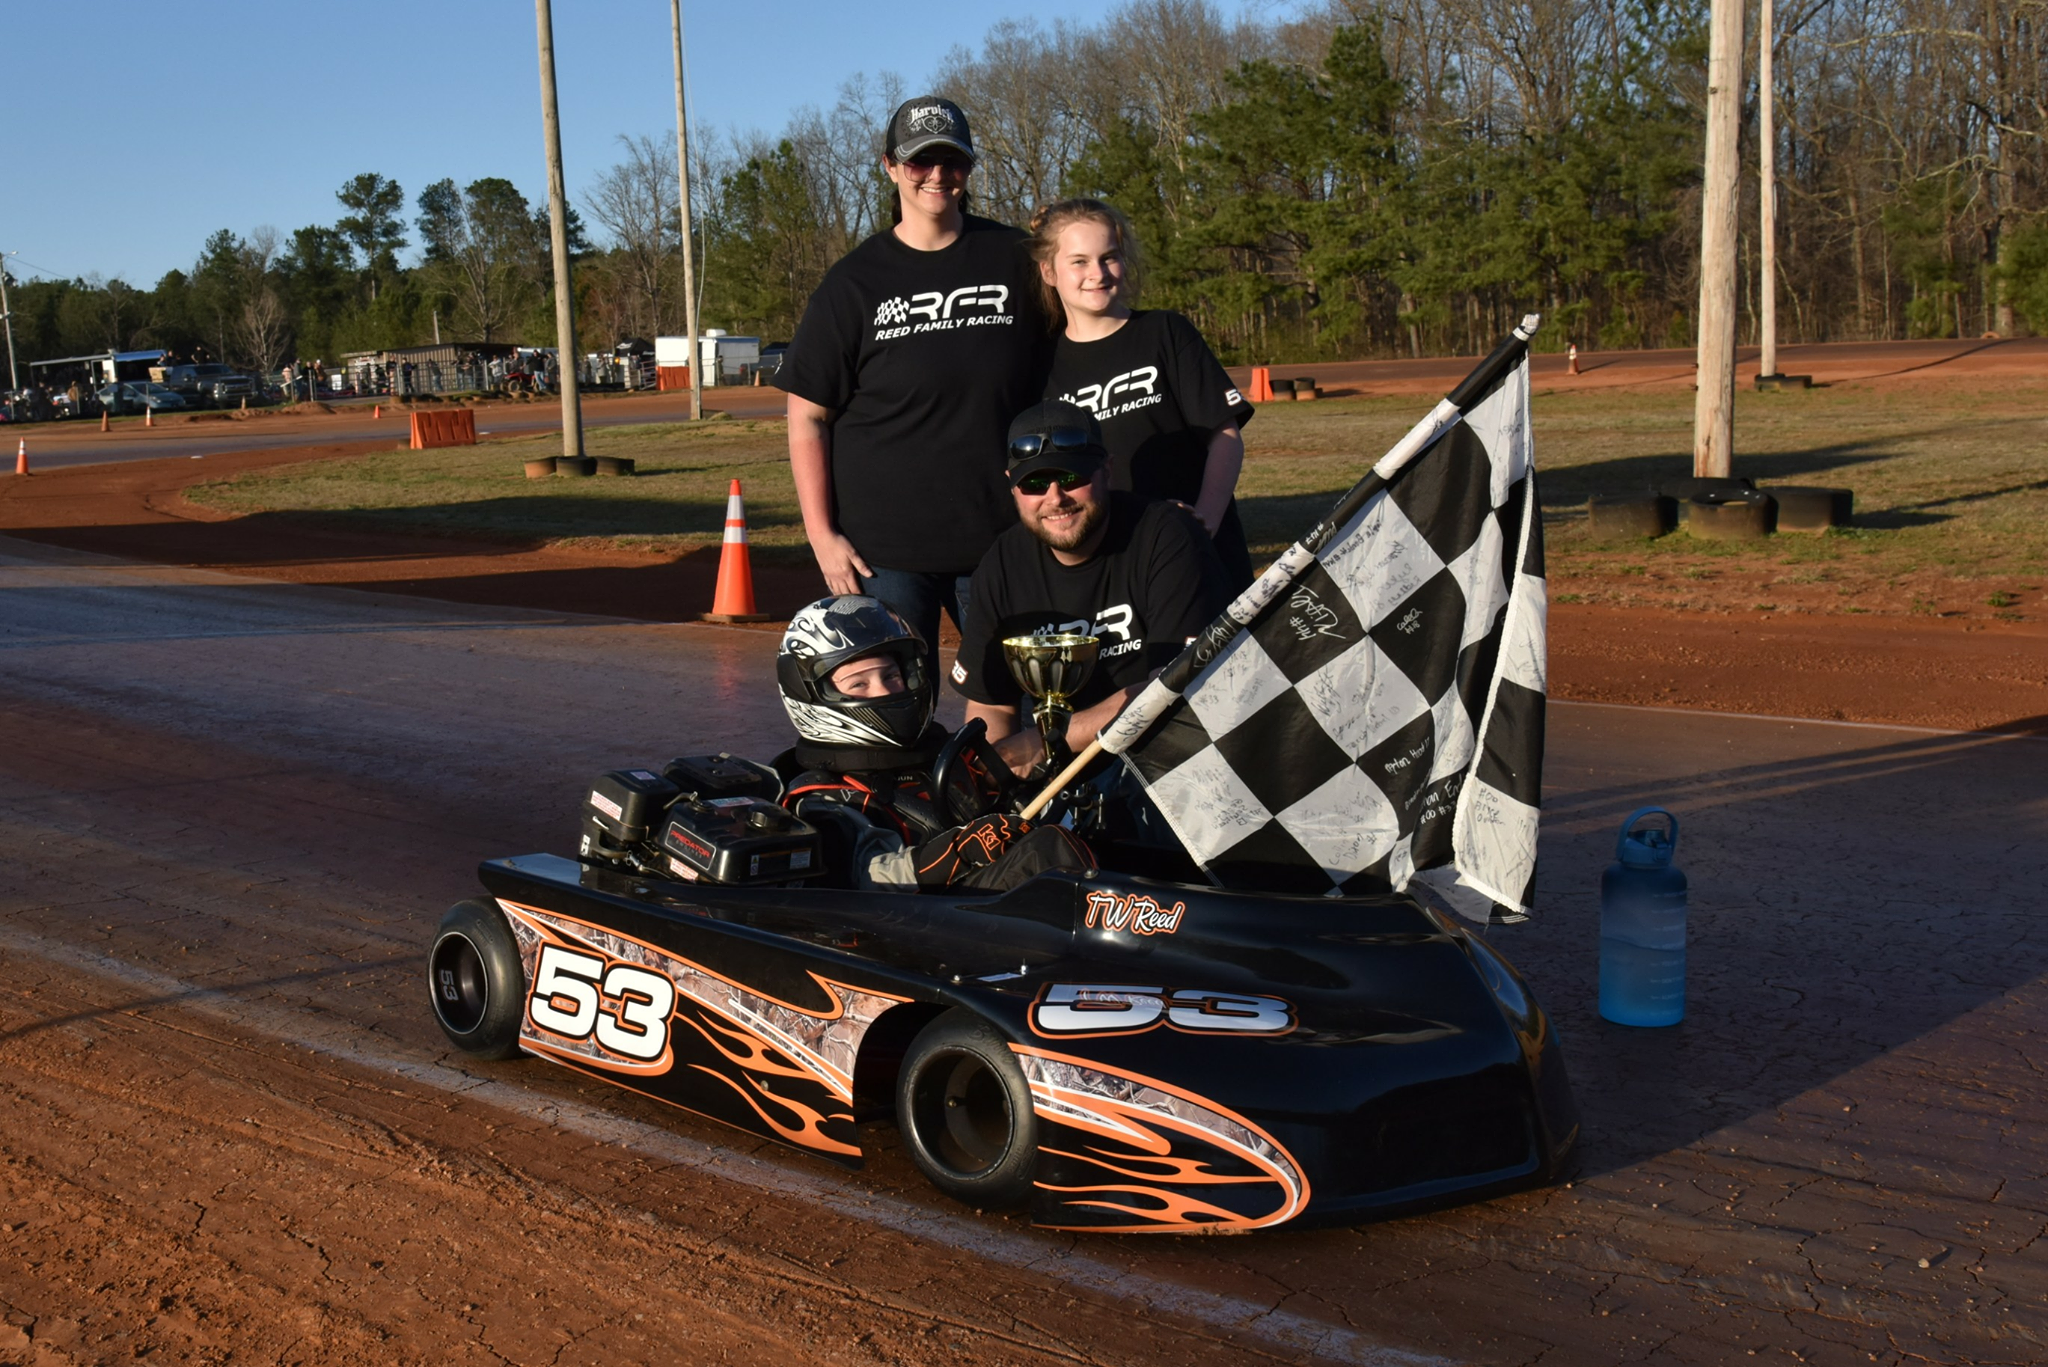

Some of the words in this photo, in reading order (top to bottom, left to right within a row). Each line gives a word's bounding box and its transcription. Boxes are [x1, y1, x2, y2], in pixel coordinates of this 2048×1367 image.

[909, 284, 1009, 320] RFR
[875, 326, 911, 341] REED
[913, 318, 964, 334] FAMILY
[966, 315, 1014, 327] RACING
[1094, 407, 1118, 421] MILY
[1121, 393, 1162, 414] RACING
[1099, 638, 1142, 660] RACING
[670, 830, 710, 858] PREDATOR
[1134, 898, 1183, 933] Reed
[440, 969, 459, 1001] 53
[530, 943, 675, 1060] 53
[1034, 983, 1292, 1035] 53
